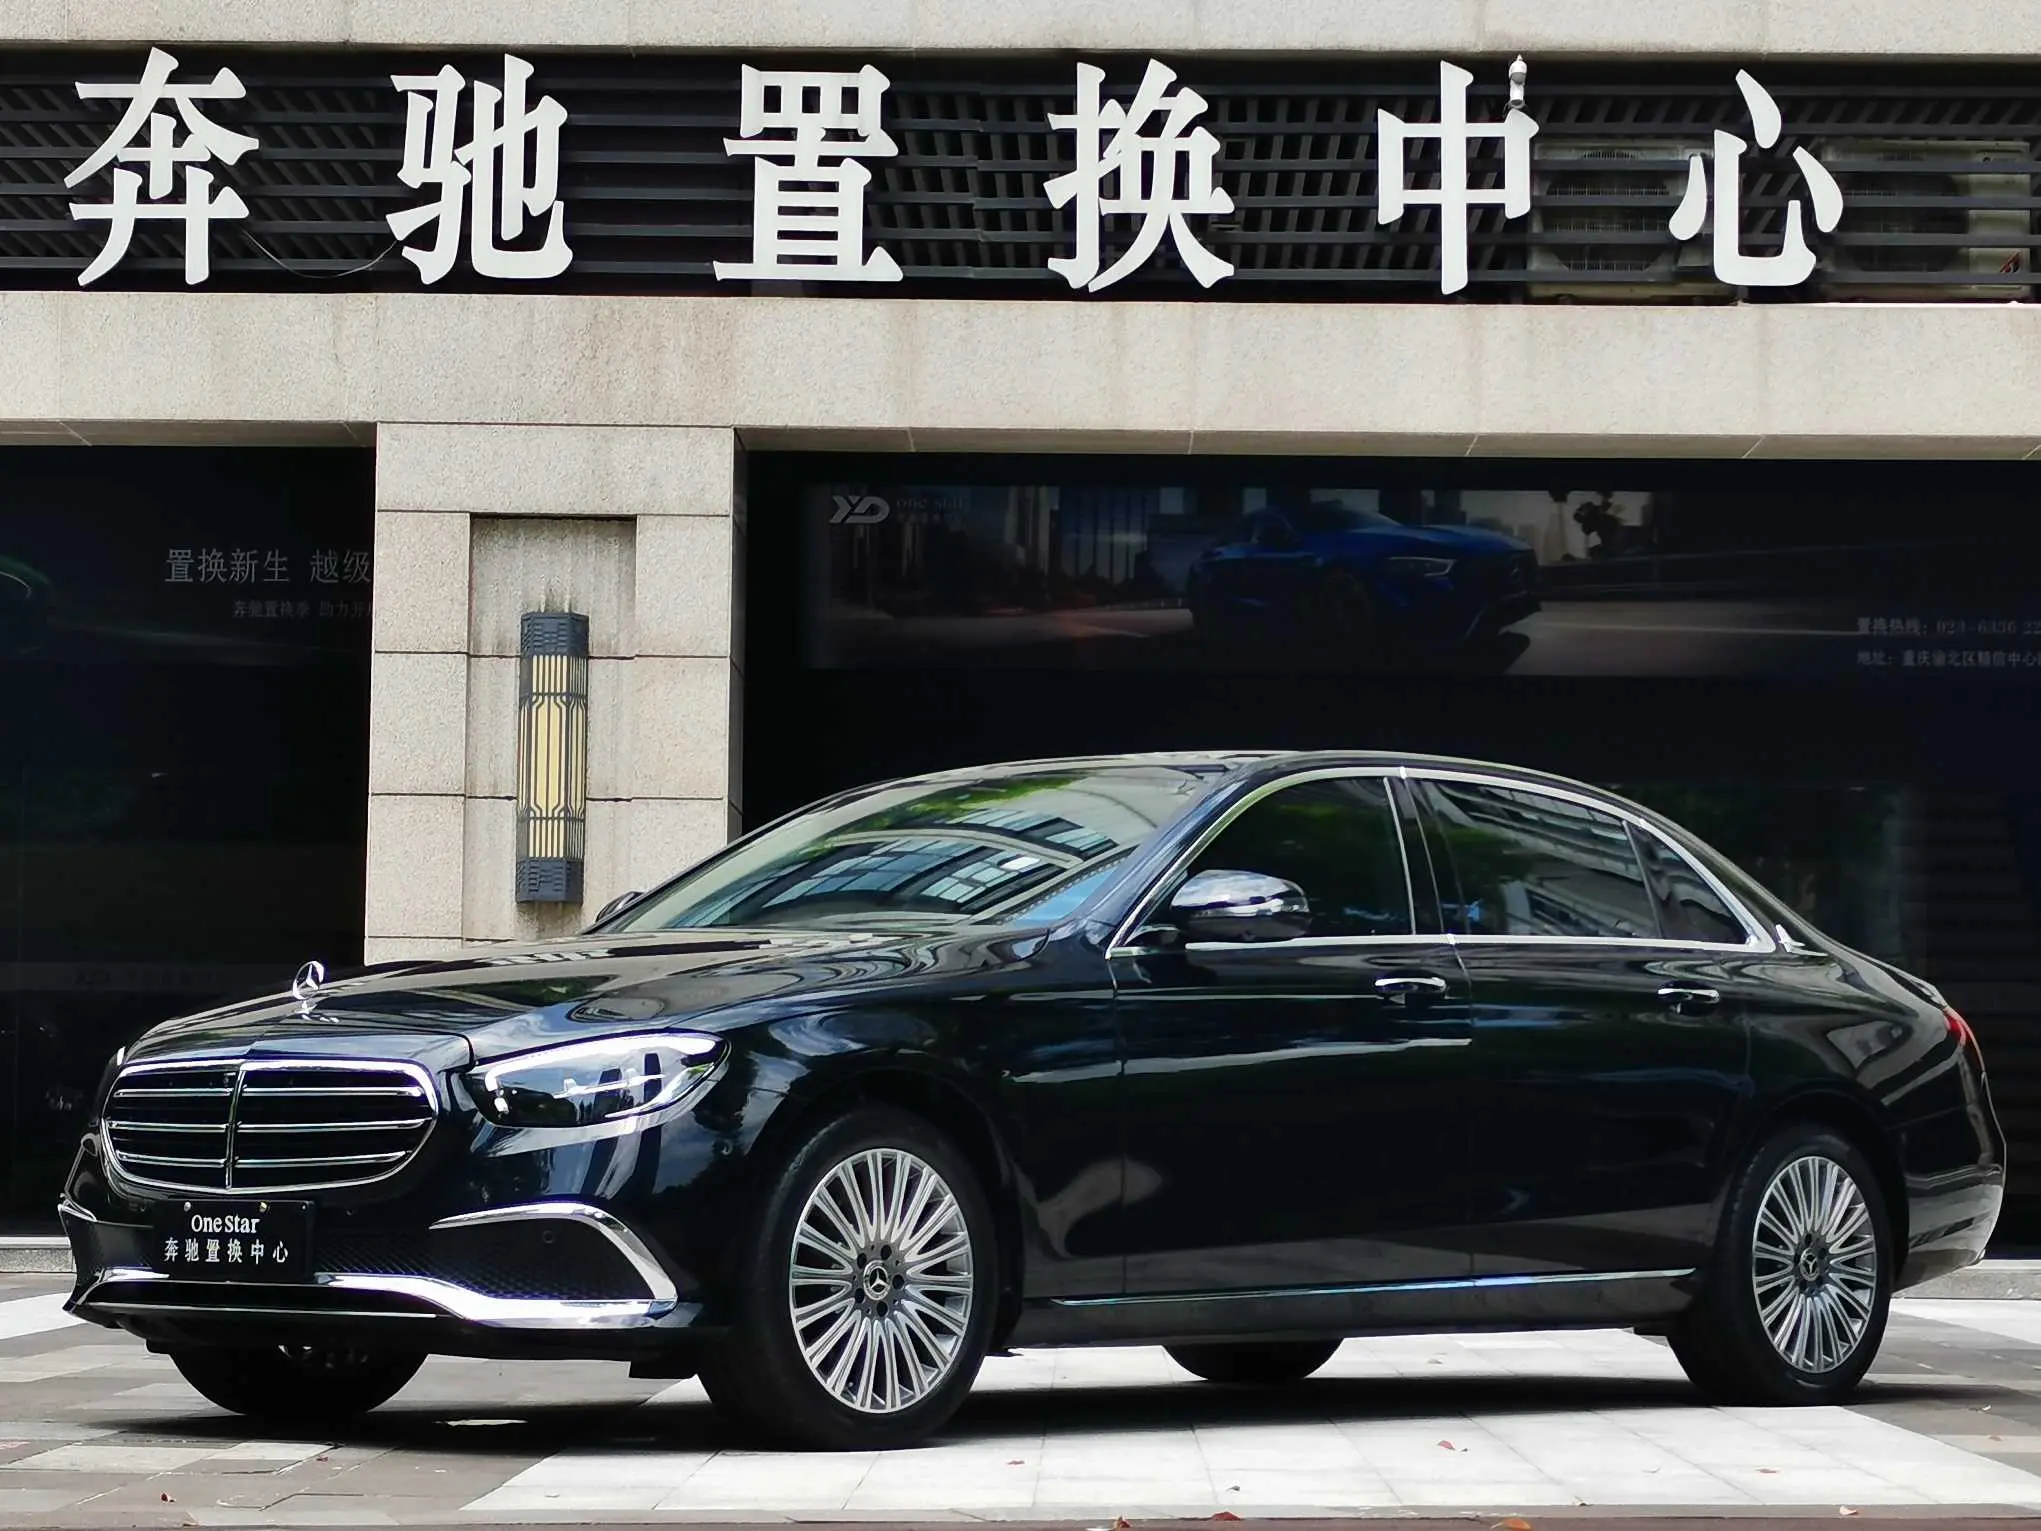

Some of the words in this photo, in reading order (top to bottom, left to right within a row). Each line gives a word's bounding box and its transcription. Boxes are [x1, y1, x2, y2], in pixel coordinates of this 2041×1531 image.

[64, 47, 1844, 295] 奔驰置换中心
[165, 548, 290, 583] 置换新生
[310, 548, 371, 583] 越级
[164, 1236, 289, 1265] 奔驰置换中心
